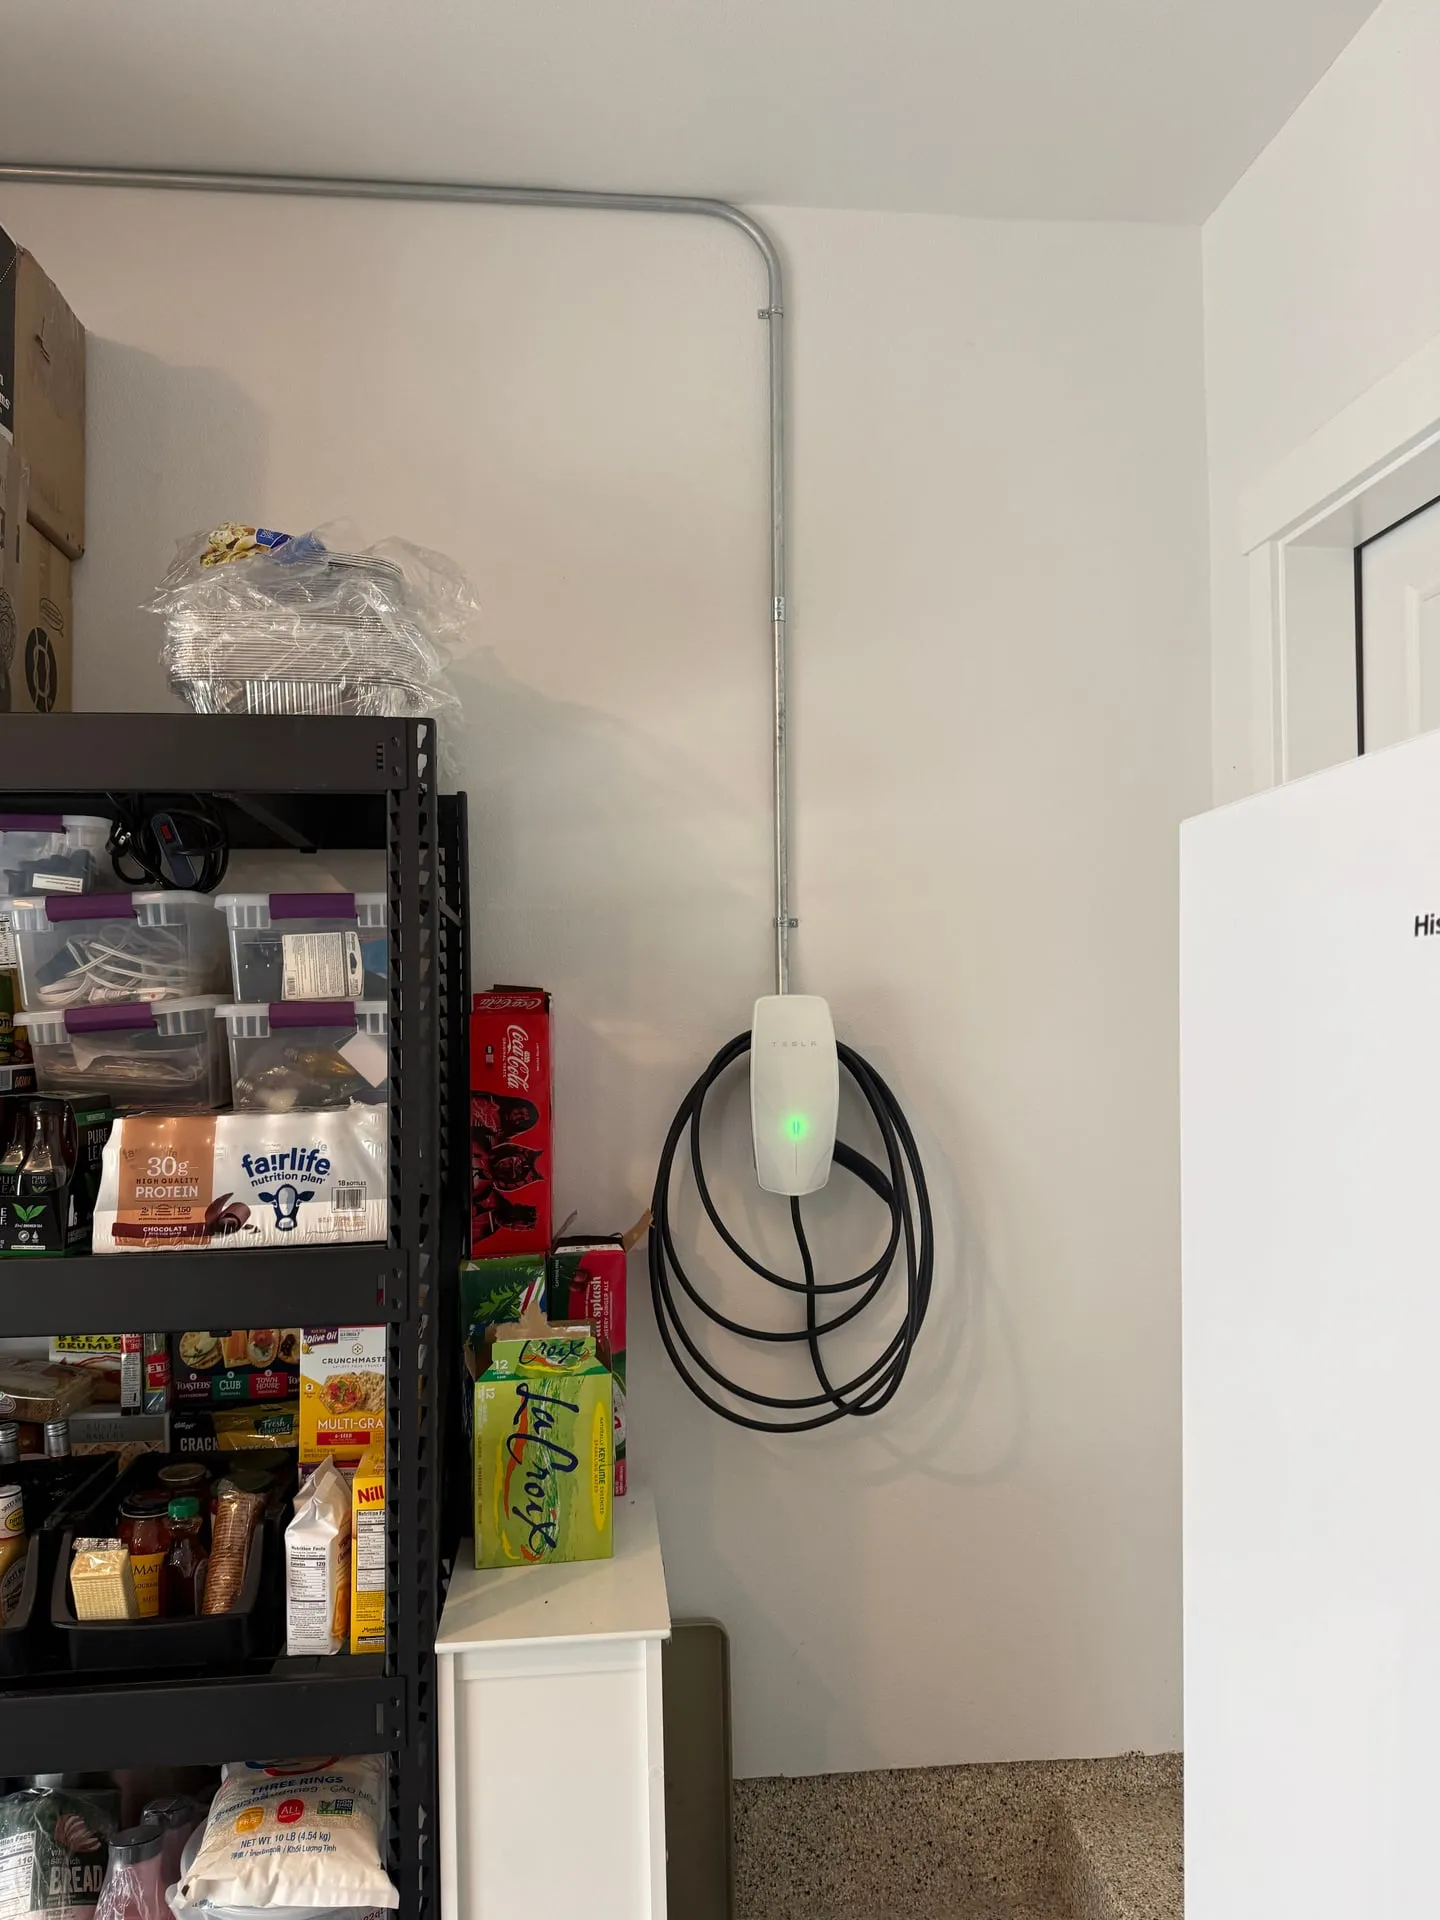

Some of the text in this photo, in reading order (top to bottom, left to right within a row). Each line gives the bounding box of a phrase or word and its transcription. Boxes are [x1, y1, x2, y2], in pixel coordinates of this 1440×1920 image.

[88, 1145, 103, 1161] LEA
[147, 1156, 189, 1177] 30g
[251, 1172, 298, 1187] nutrition
[135, 1186, 198, 1198] PROTEIN
[590, 1275, 603, 1318] splash
[307, 1331, 338, 1344] Olive Oil
[322, 1356, 386, 1364] CRUNCHMASTE
[494, 1360, 508, 1370] 12
[219, 1380, 241, 1391] CLUB
[256, 1376, 278, 1384] TOWN
[256, 1382, 279, 1391] HOUSE
[486, 1388, 495, 1399] 12
[262, 1417, 287, 1429] Fresh
[318, 1418, 384, 1430] MULTI-GRA
[180, 1437, 218, 1452] CRACK
[598, 1447, 606, 1463] KEY
[598, 1464, 606, 1484] LIME
[357, 1485, 384, 1504] Nill
[133, 1564, 160, 1576] MAT
[251, 1780, 297, 1795] THREE
[300, 1776, 344, 1785] RINGS
[240, 1838, 257, 1849] NET
[275, 1834, 284, 1842] 10
[286, 1832, 296, 1841] LB
[298, 1831, 317, 1843] (4.54
[319, 1831, 331, 1842] kg)
[18, 1855, 33, 1865] 110
[49, 1865, 103, 1895] BREAD
